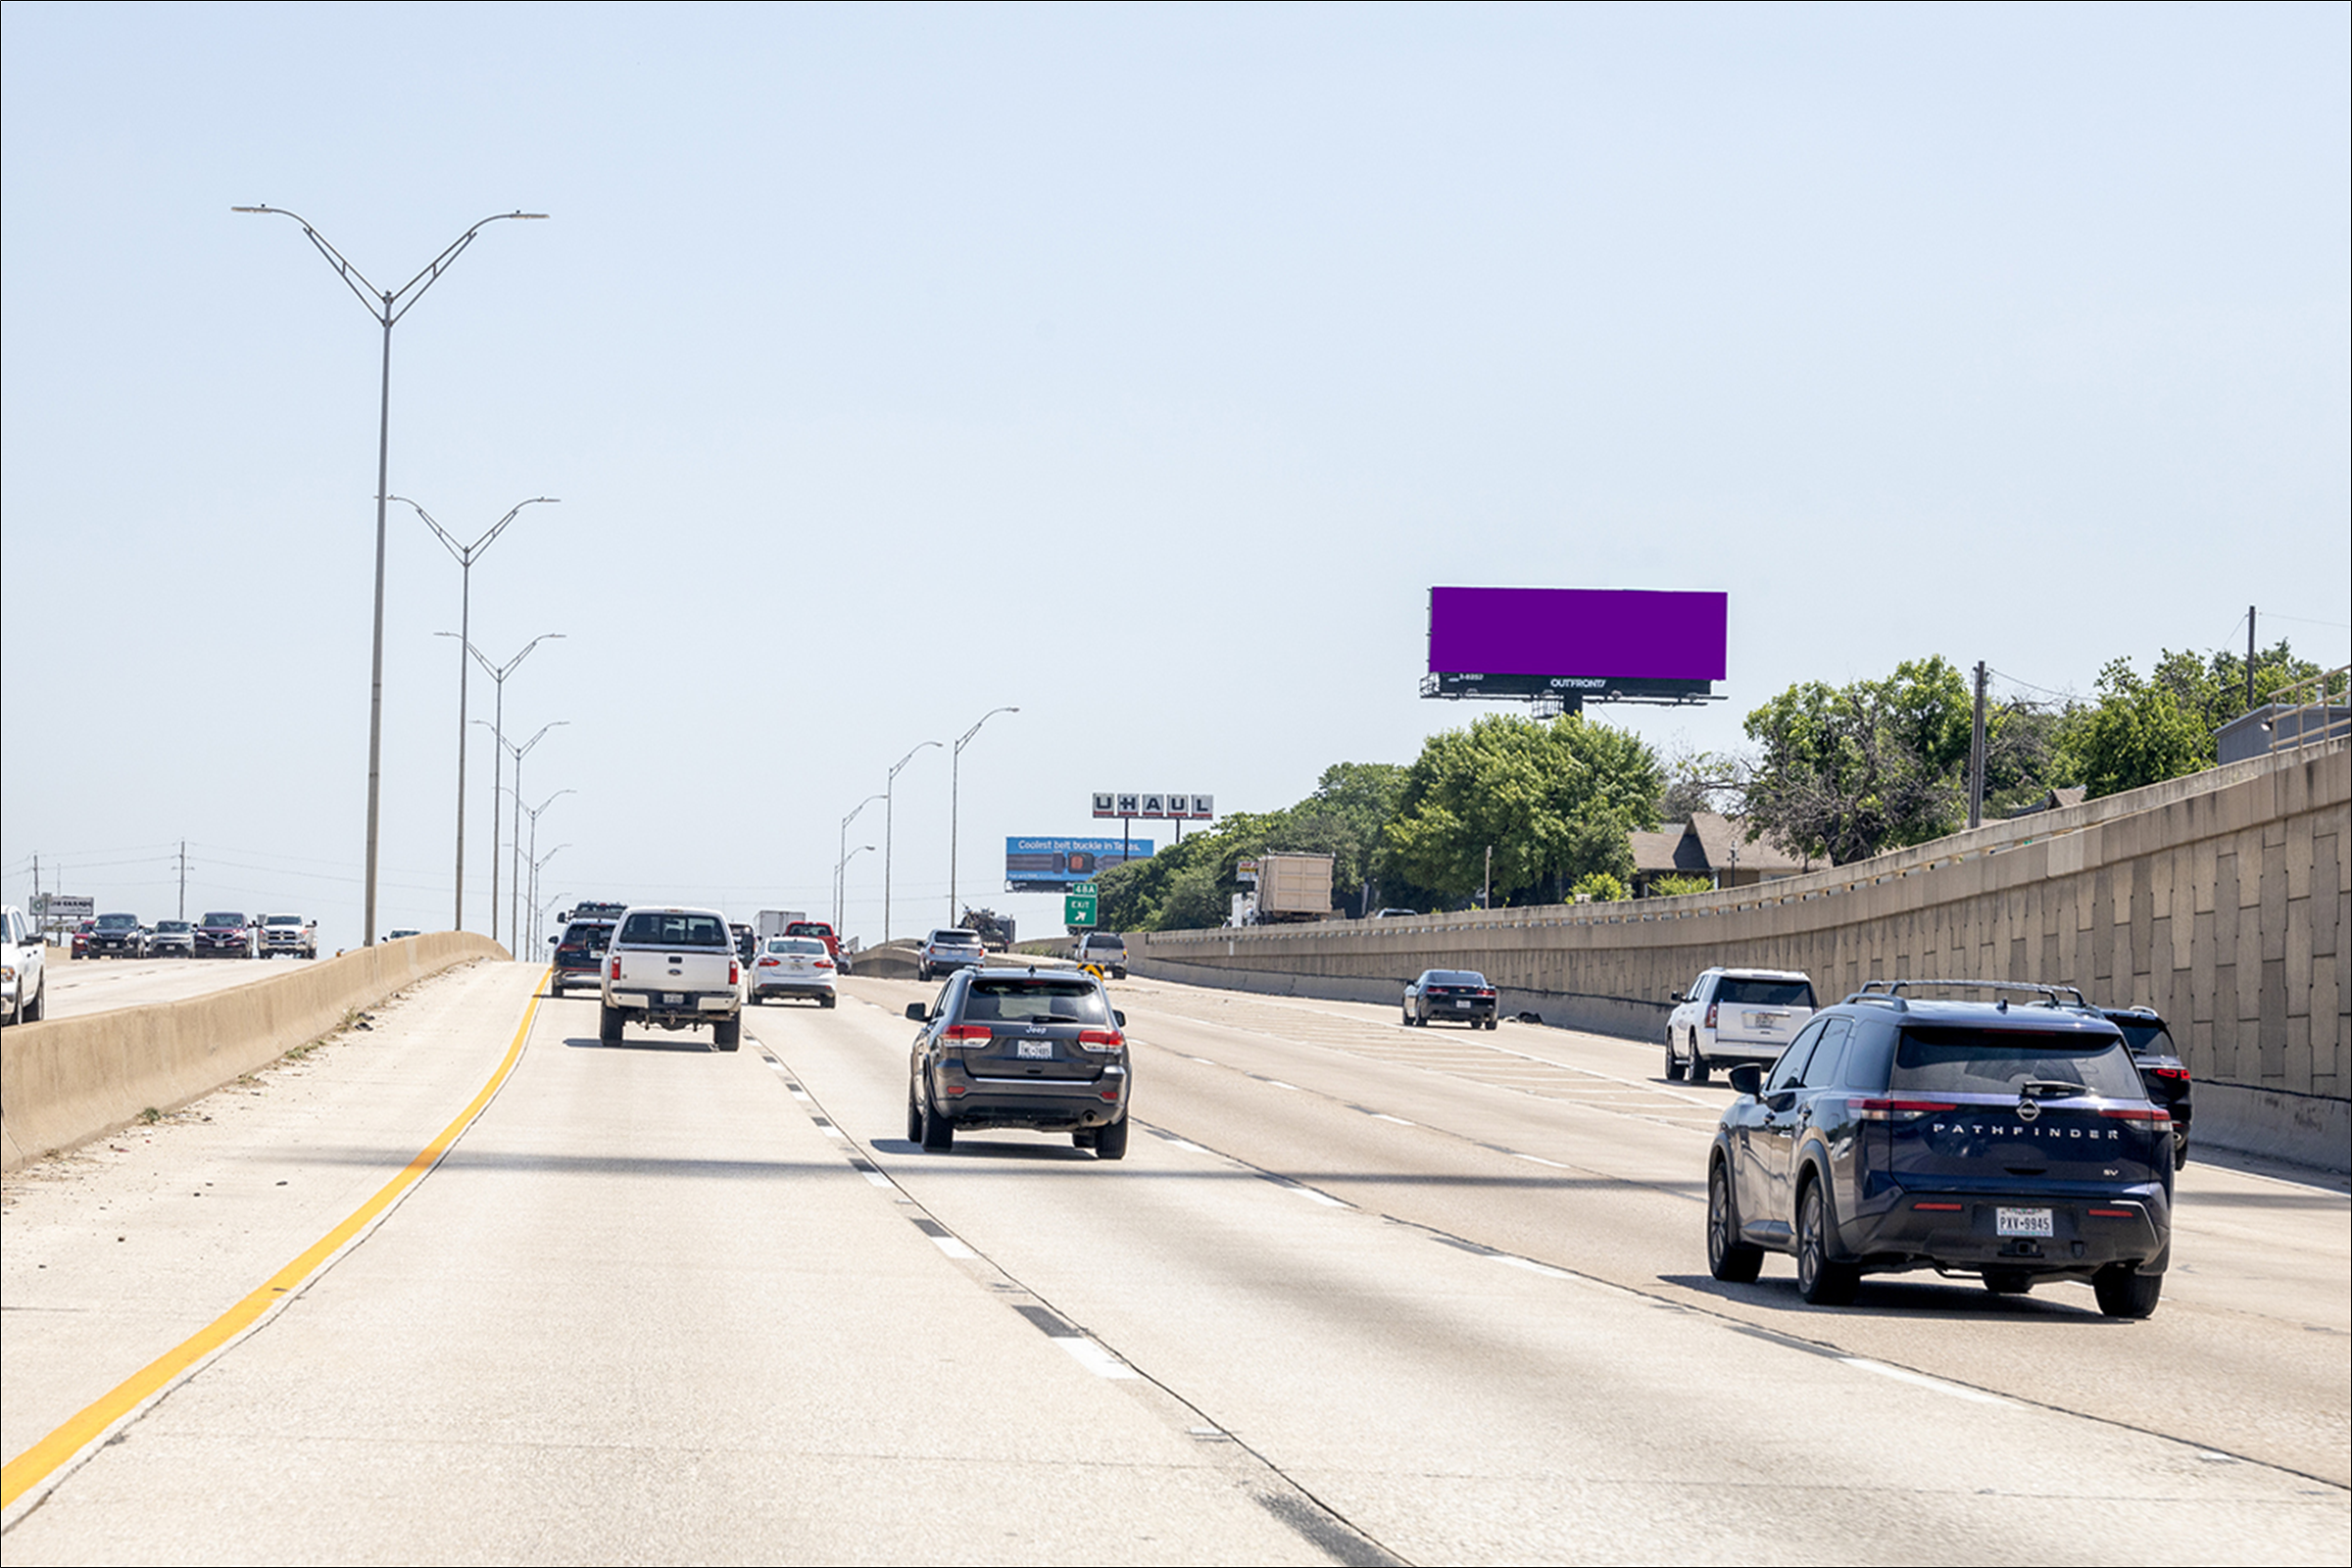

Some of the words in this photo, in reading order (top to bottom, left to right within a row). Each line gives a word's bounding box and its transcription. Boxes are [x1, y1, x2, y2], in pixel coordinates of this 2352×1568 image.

[1018, 840, 1052, 850] Coolest
[1054, 840, 1071, 850] belt
[1072, 841, 1102, 851] buckle
[1103, 841, 1112, 851] in
[1075, 885, 1095, 894] 48A
[1025, 1025, 1047, 1035] Jeep
[1933, 1123, 2119, 1140] PATHFINDER
